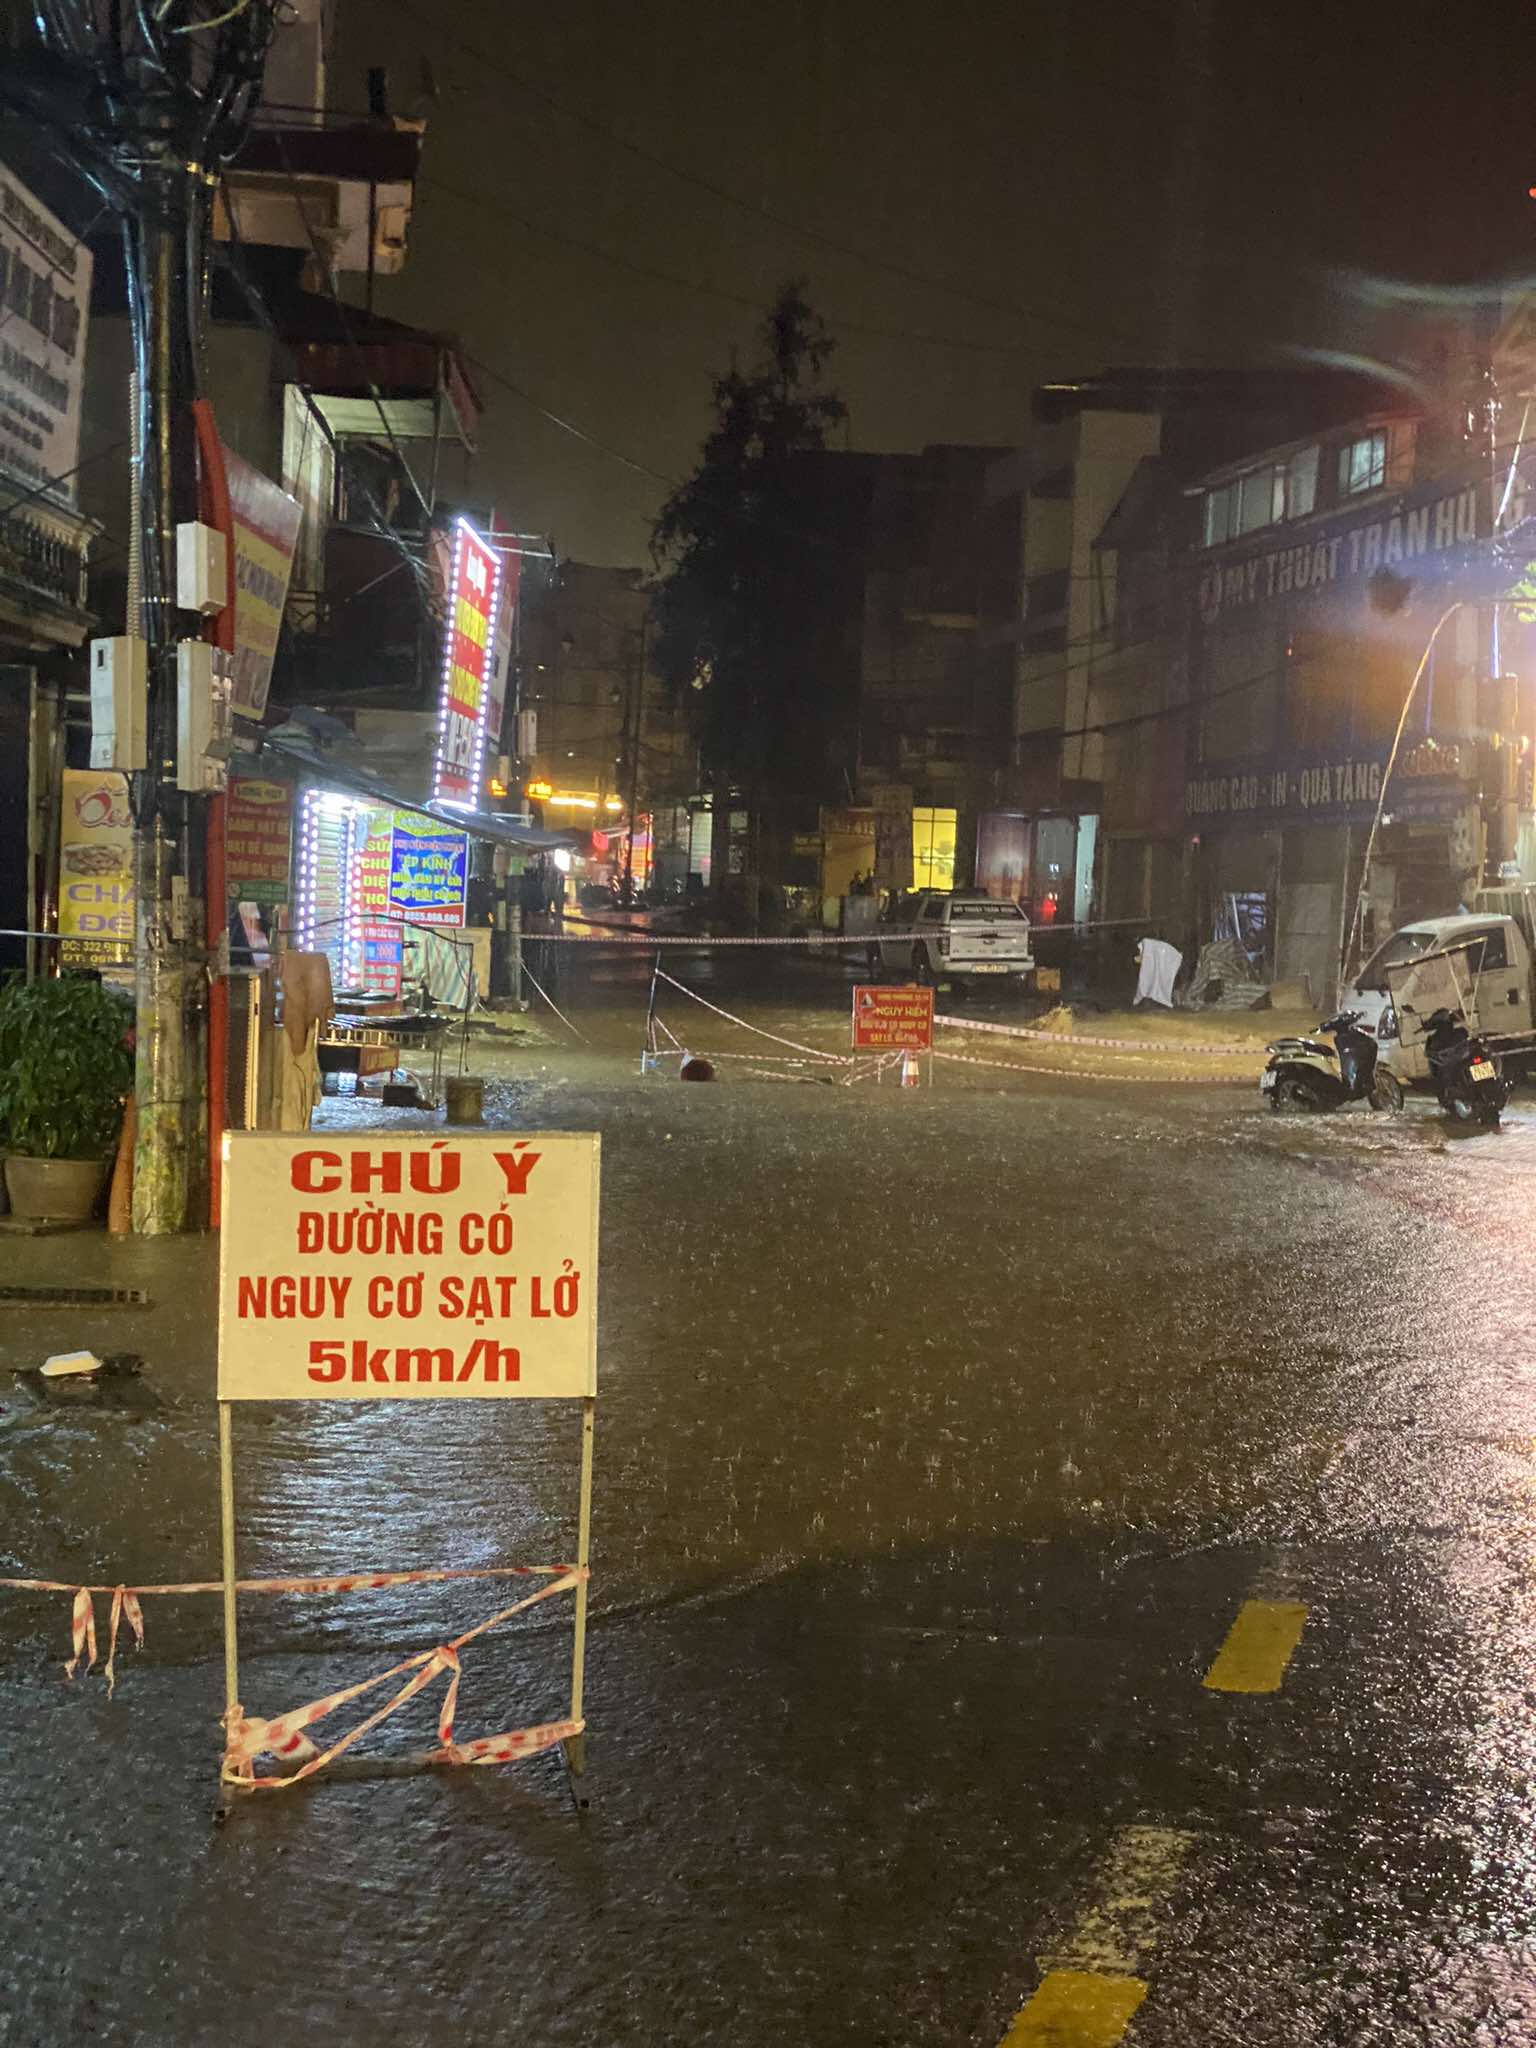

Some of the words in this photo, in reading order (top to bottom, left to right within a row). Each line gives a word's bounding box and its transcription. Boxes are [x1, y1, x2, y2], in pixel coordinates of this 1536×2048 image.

[291, 1141, 461, 1194] CHÚ
[493, 1141, 542, 1195] Ý
[297, 1201, 444, 1255] ĐƯỜNG
[459, 1199, 513, 1255] CÓ
[238, 1276, 352, 1319] NGUY
[368, 1272, 424, 1319] CƠ
[439, 1276, 517, 1325] SẠT
[531, 1258, 580, 1318] LỞ
[307, 1339, 521, 1383] 5km/h
